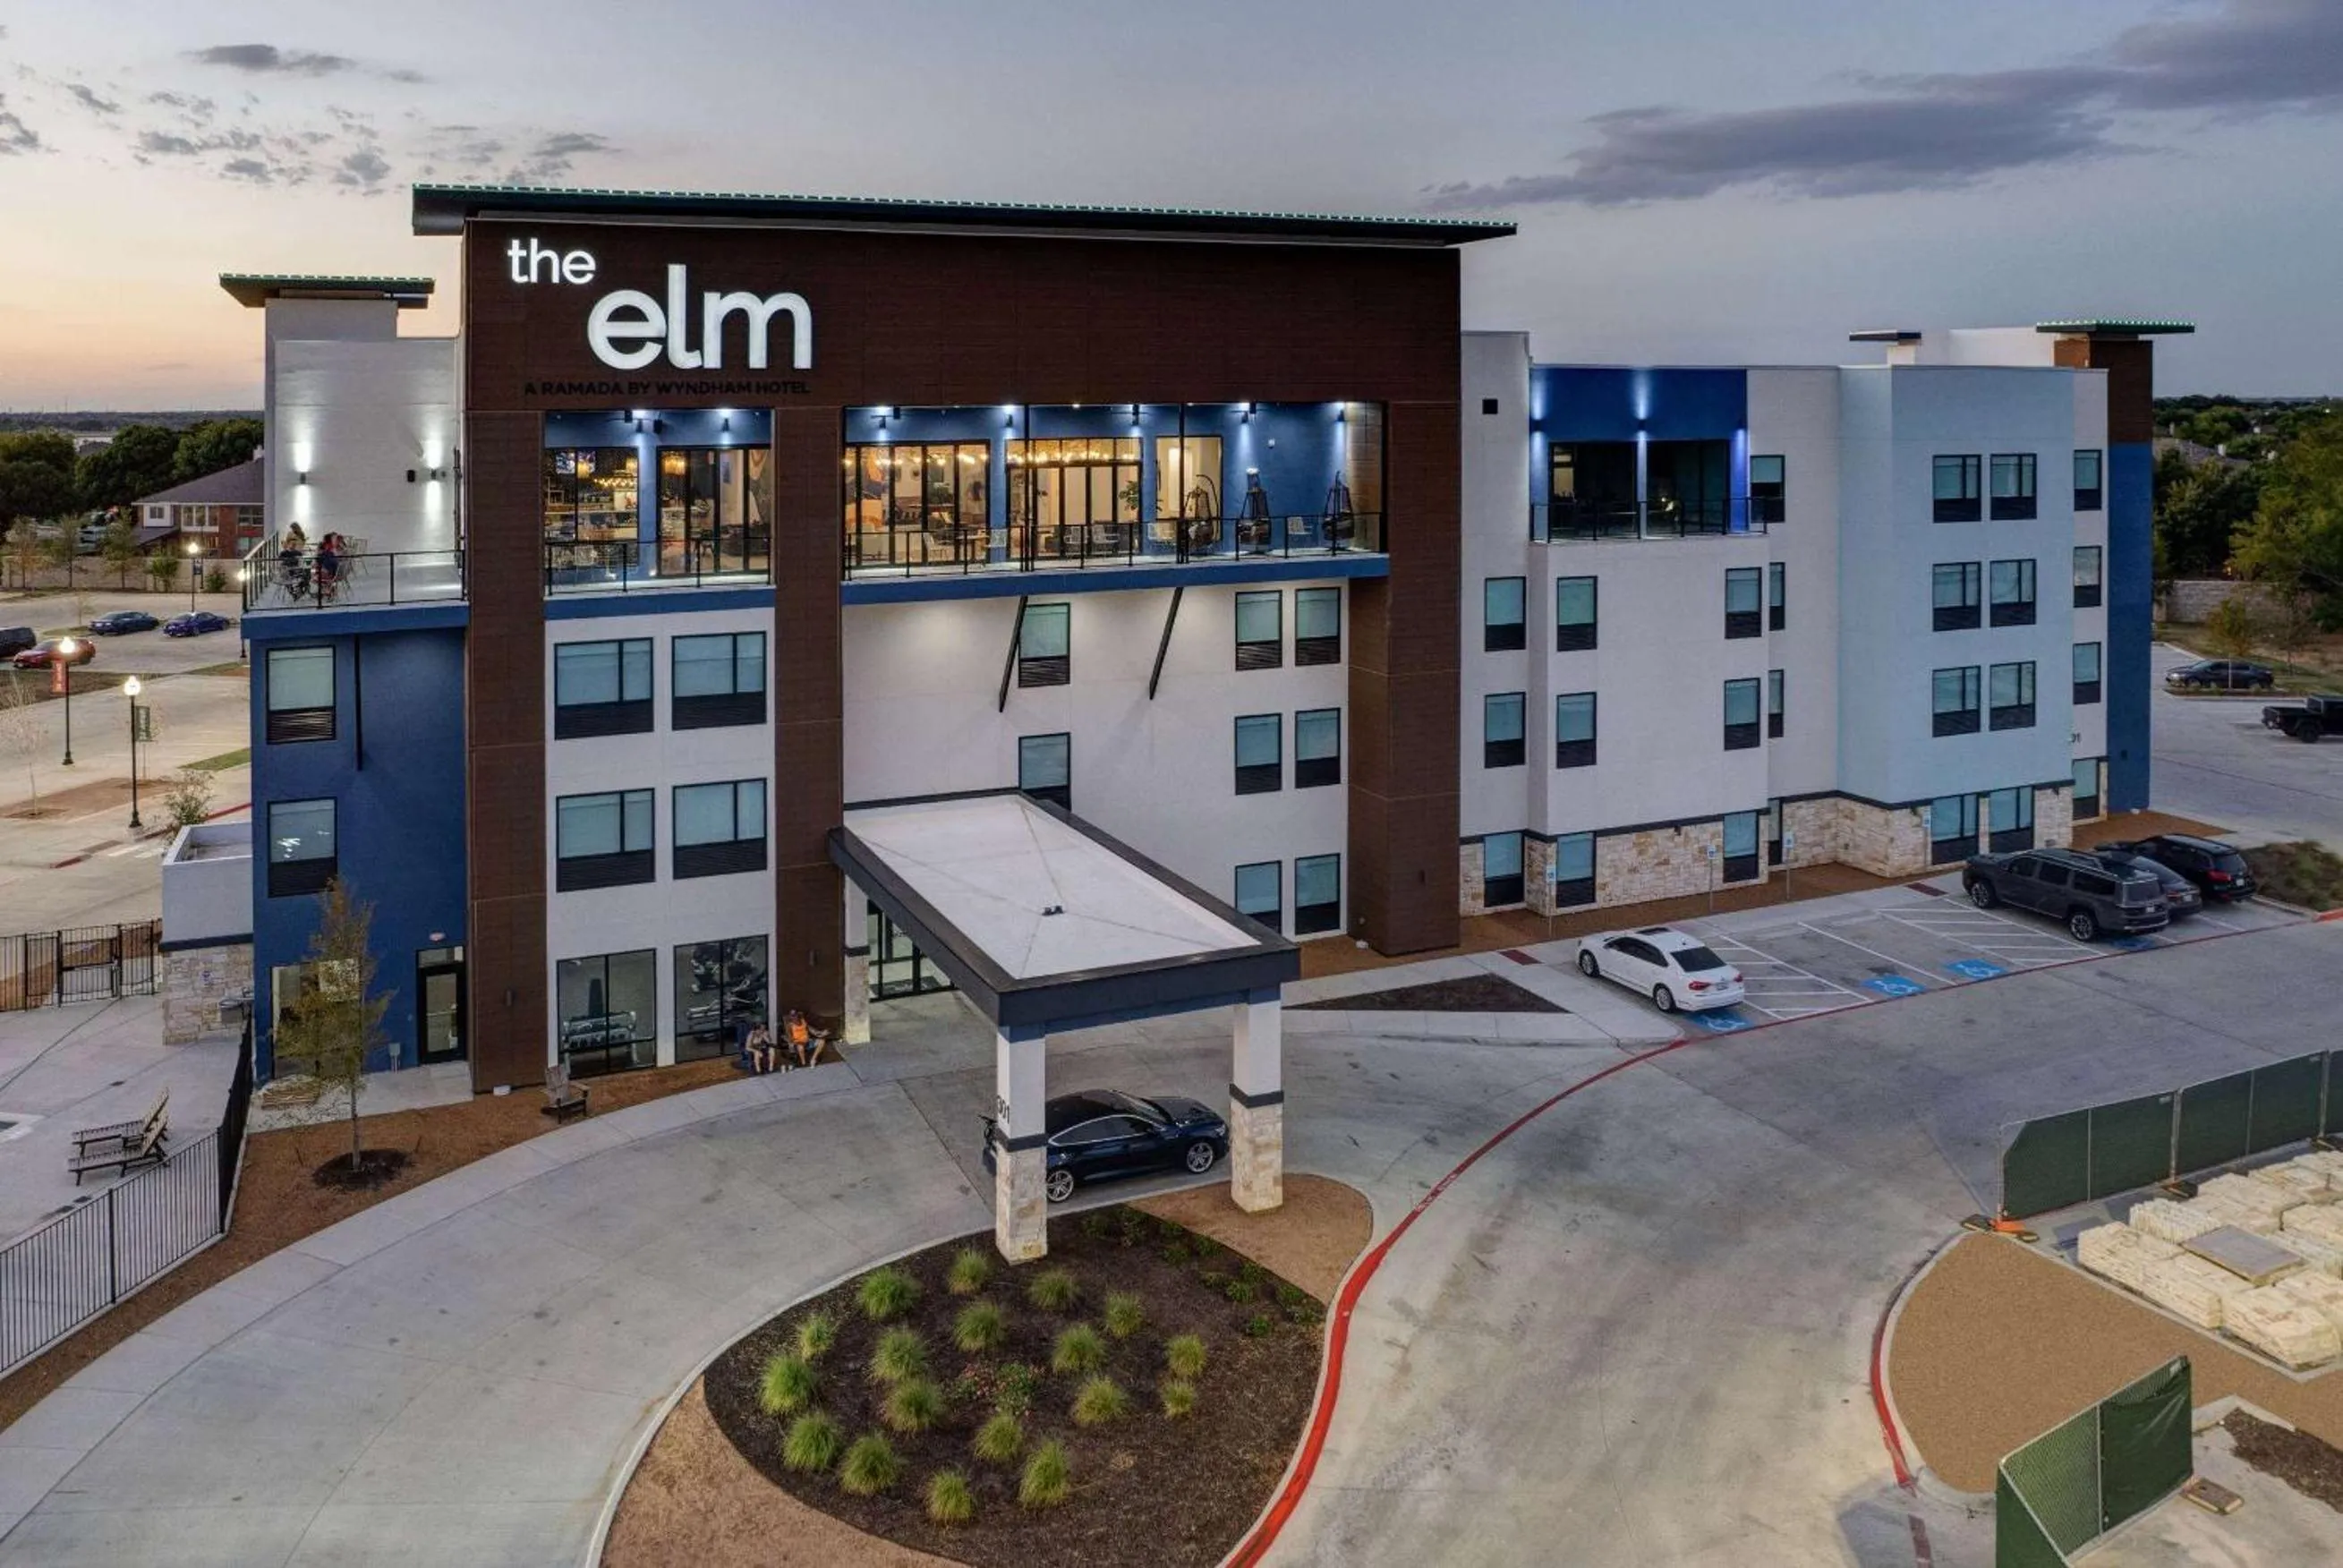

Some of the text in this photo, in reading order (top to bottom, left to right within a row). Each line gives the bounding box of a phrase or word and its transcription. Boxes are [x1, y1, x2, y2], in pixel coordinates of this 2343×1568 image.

[507, 237, 596, 285] the
[587, 263, 813, 370] elm
[524, 380, 812, 396] A RAMADA BY WYNDHAM HOTEL
